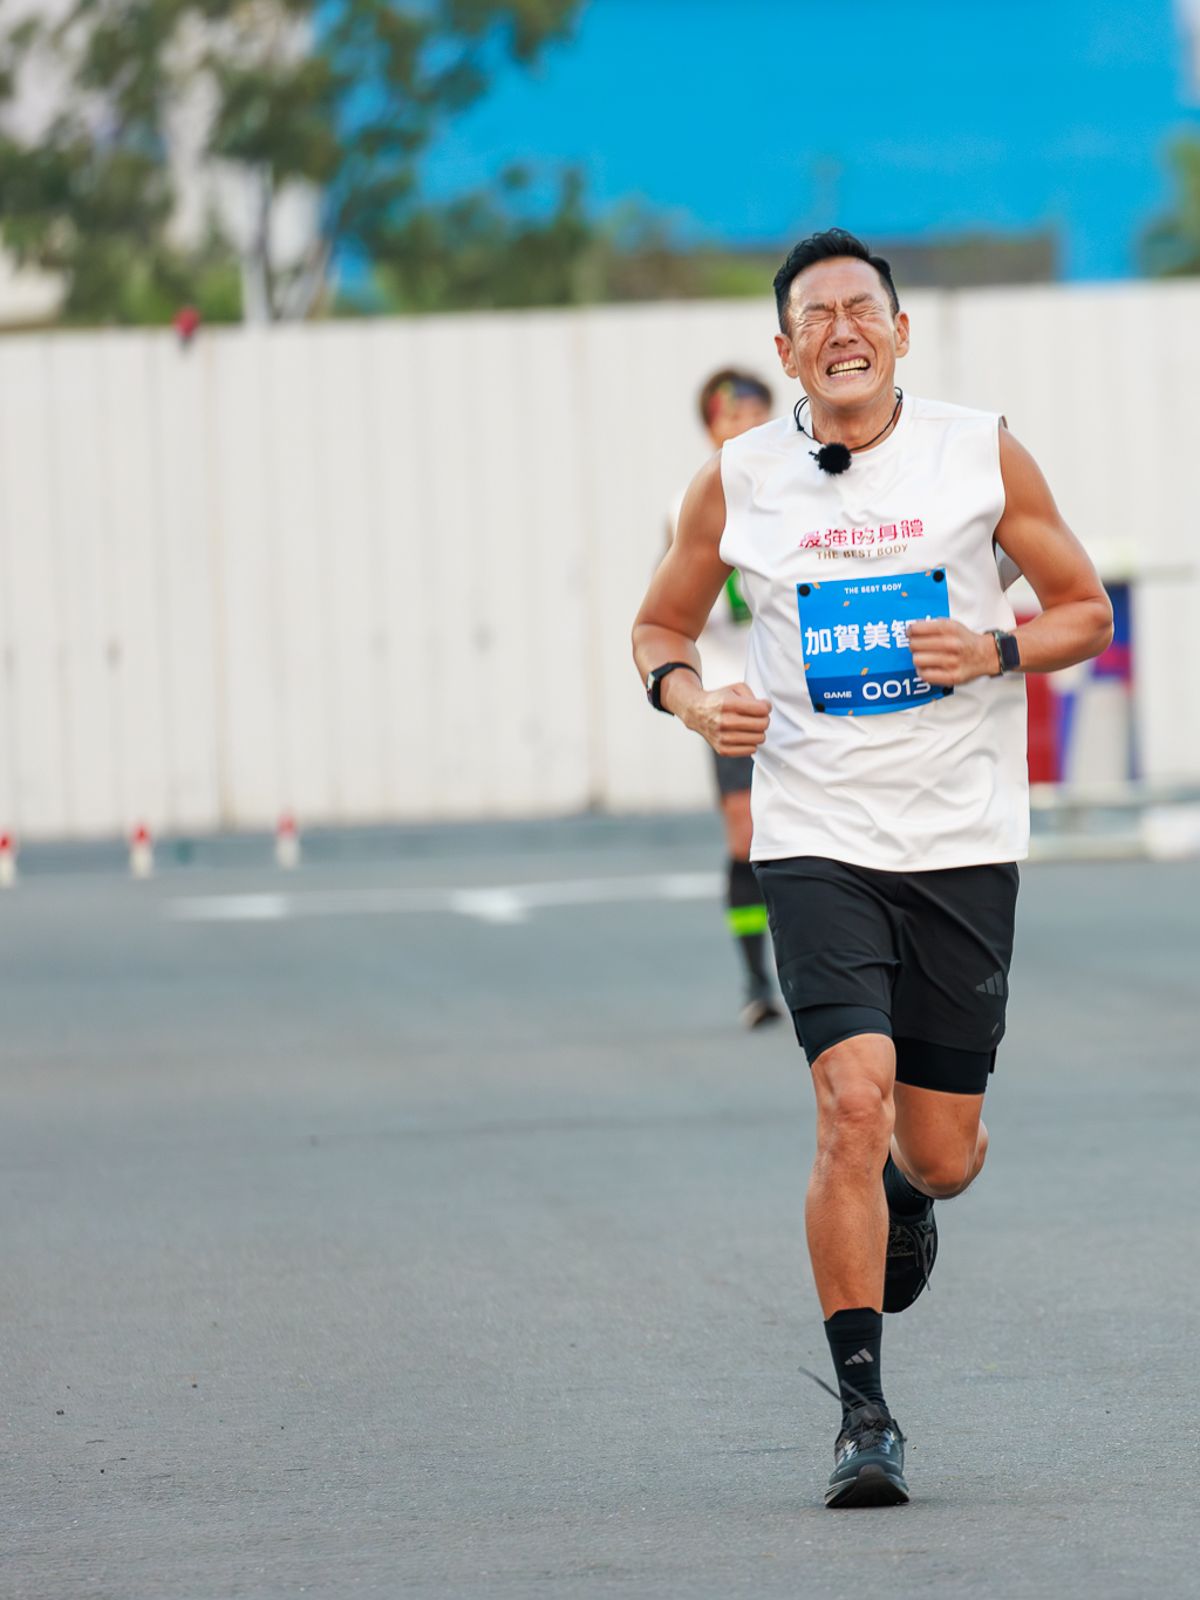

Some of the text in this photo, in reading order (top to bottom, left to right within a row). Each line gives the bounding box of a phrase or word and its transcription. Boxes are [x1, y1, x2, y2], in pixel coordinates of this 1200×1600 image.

[816, 543, 909, 561] THE BEST BODY
[844, 582, 902, 595] THE BEST BODY
[805, 615, 938, 656] 加賀美智
[823, 677, 932, 701] GAME 0013
